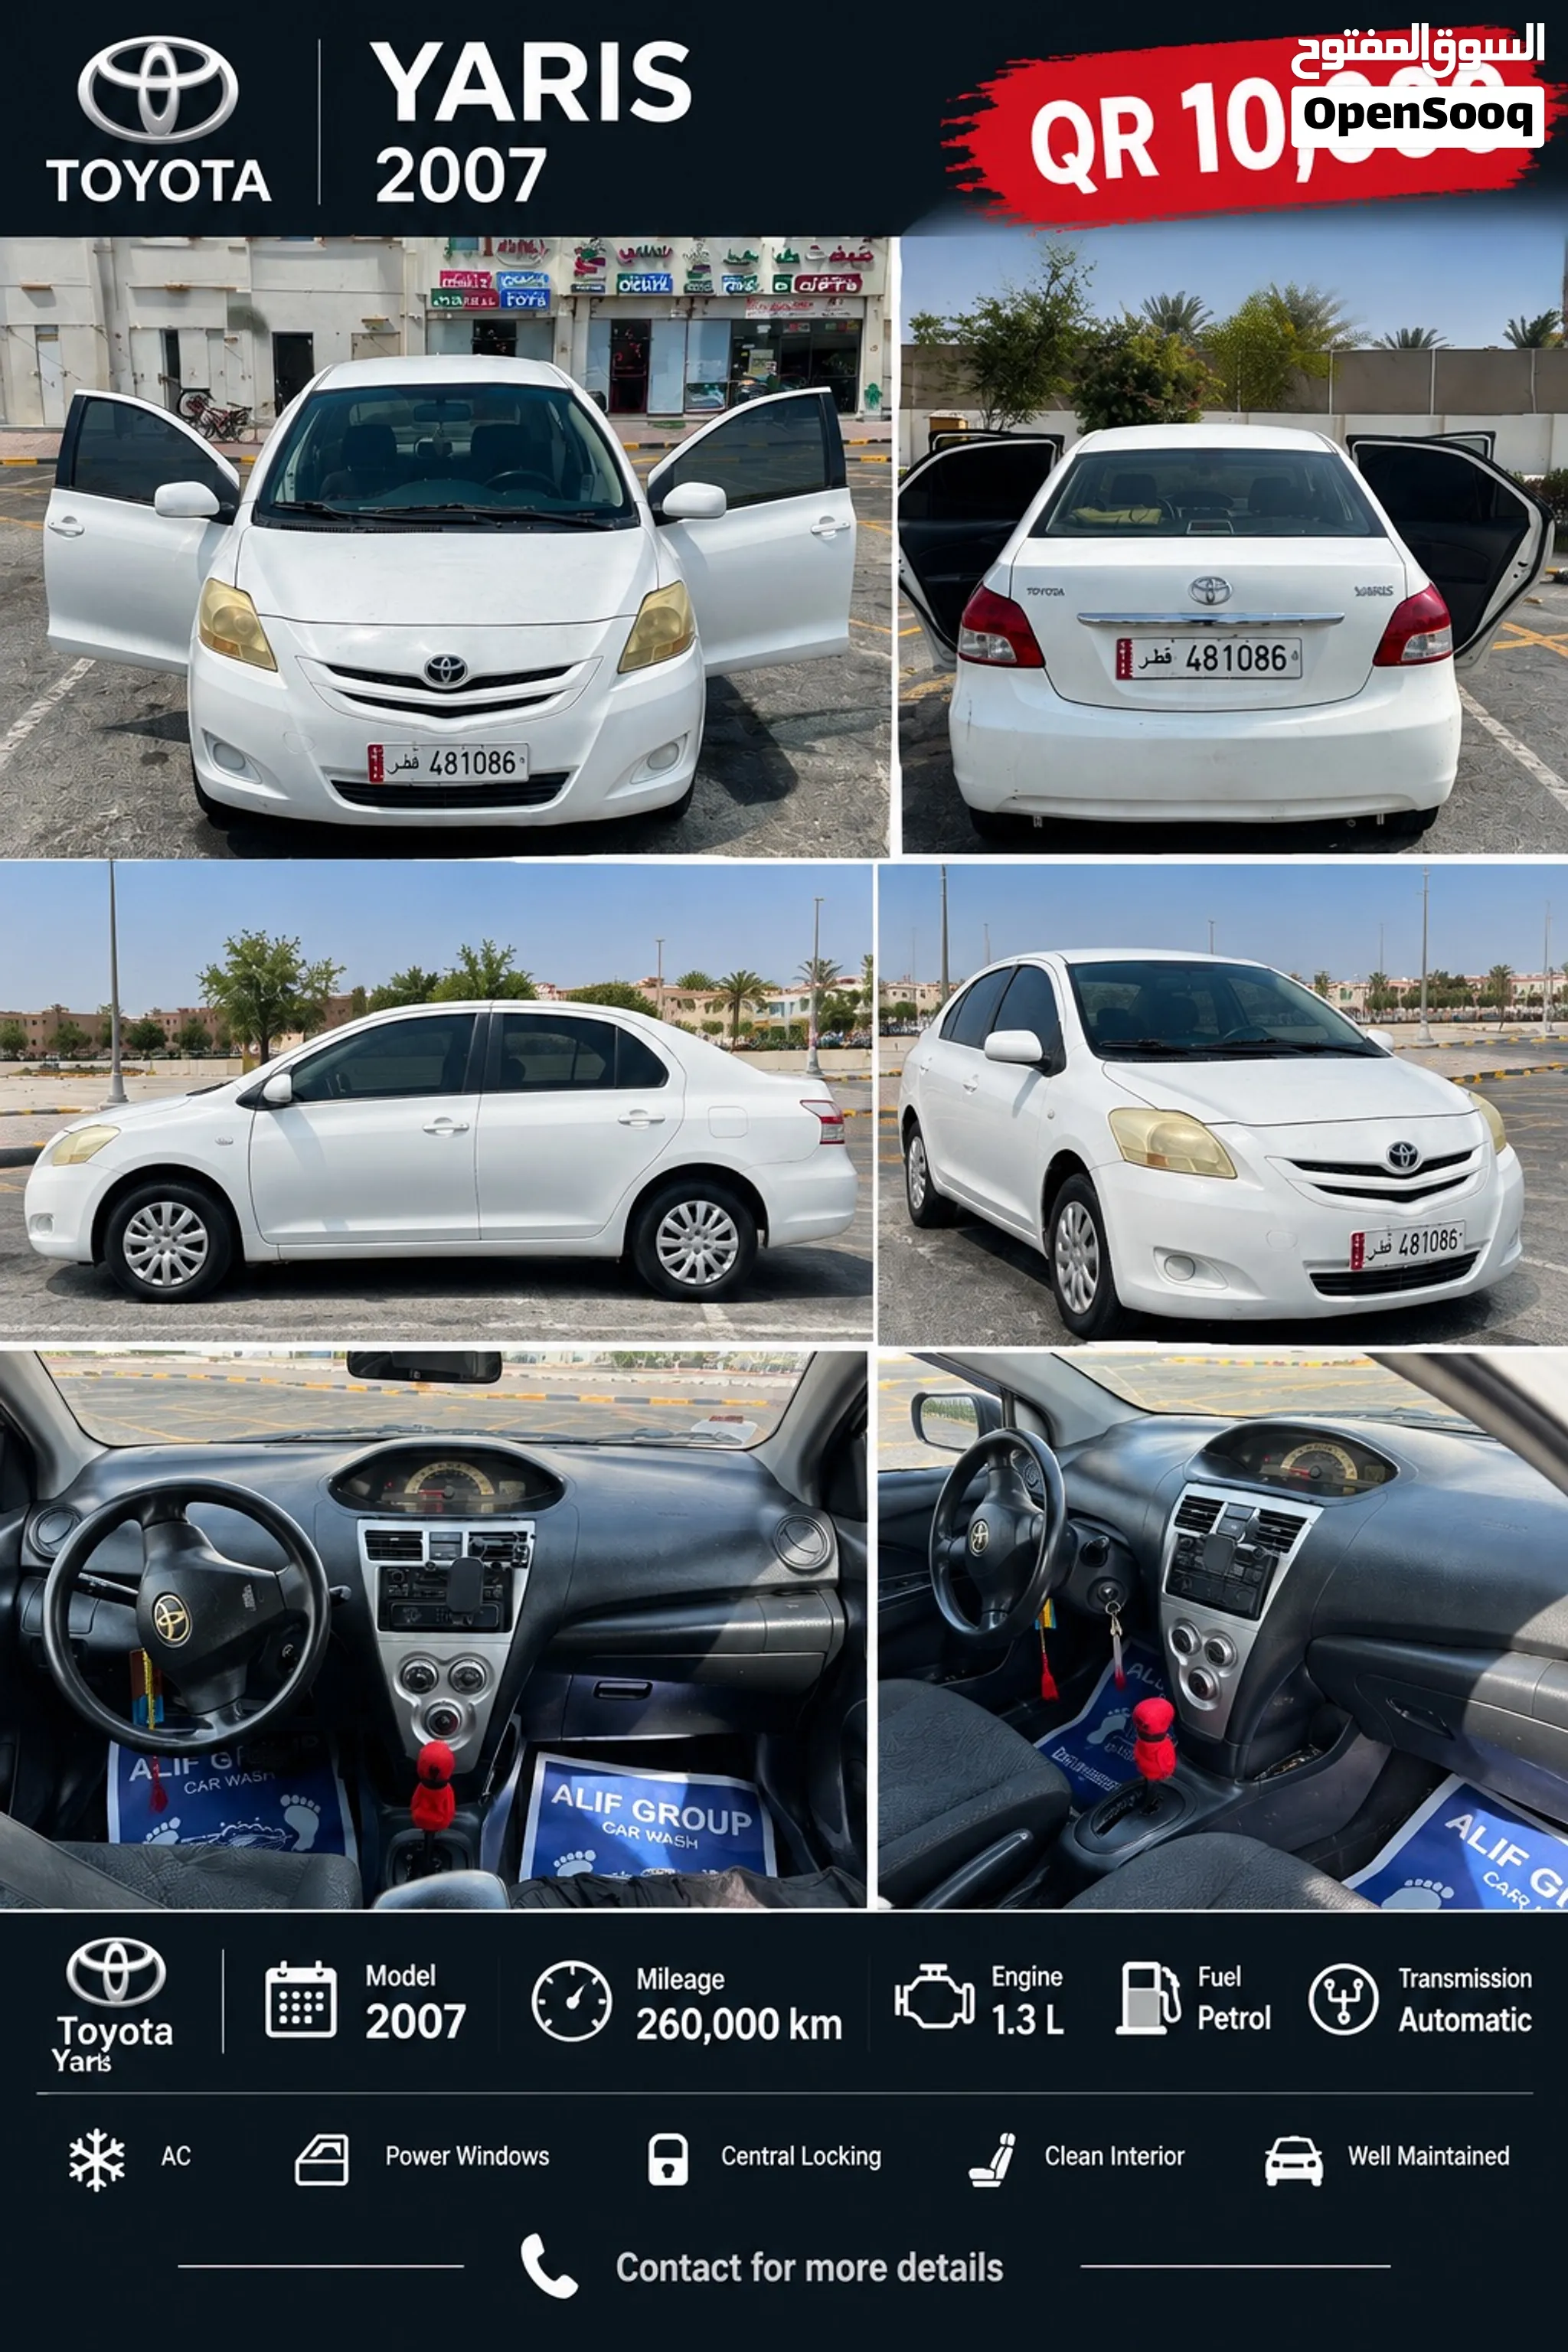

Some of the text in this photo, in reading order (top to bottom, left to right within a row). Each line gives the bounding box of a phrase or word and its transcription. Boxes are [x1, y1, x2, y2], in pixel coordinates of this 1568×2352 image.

[1138, 647, 1173, 669] قطر
[1186, 645, 1287, 671] 481086
[429, 750, 516, 776] 481086
[1398, 1227, 1459, 1256] 481086
[129, 1756, 200, 1782] ALIF
[183, 1779, 222, 1795] CAR
[550, 1783, 753, 1836] ALIF GROUP
[602, 1821, 698, 1850] CAR WASH
[1444, 1813, 1530, 1868] ALIF
